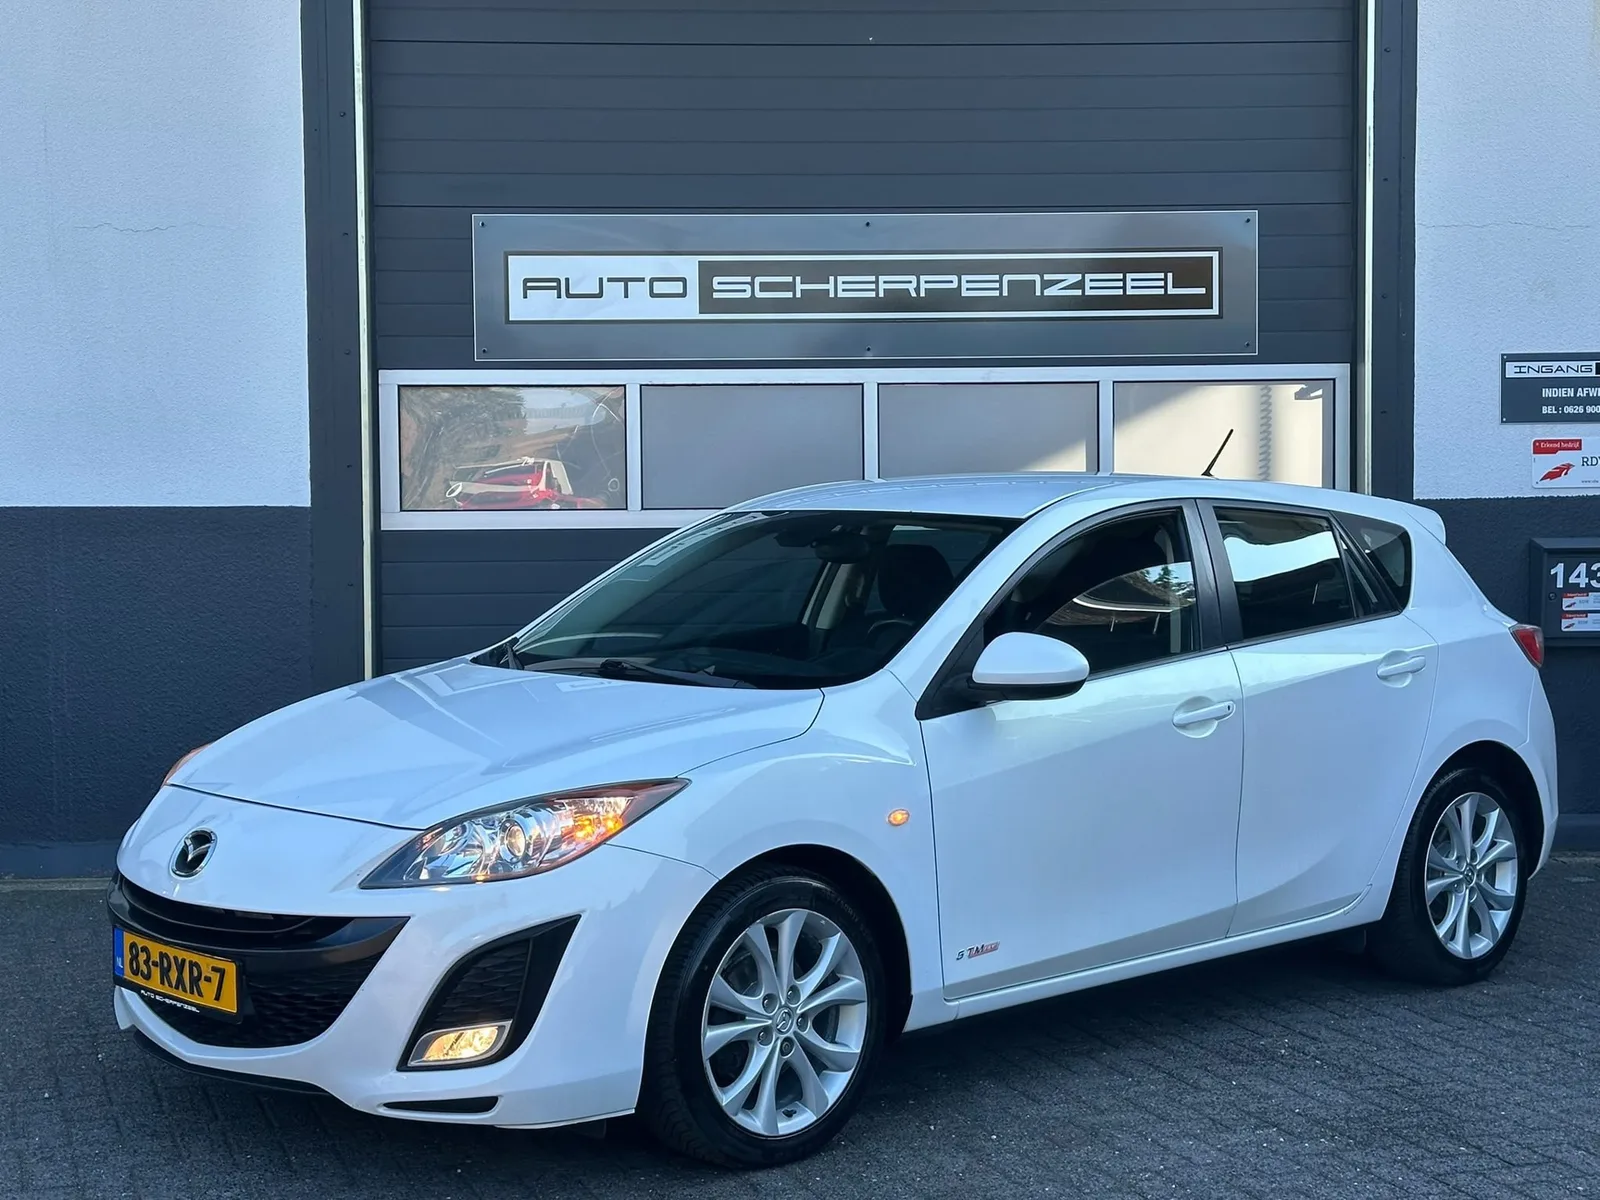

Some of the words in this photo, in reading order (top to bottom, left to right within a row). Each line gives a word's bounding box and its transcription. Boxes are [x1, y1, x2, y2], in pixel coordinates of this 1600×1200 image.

[522, 276, 688, 299] AUTO
[711, 272, 1206, 299] SCHERPENZEEL
[1513, 364, 1593, 374] INGANG
[1542, 387, 1574, 397] INDIEN
[1542, 405, 1557, 414] BEL
[1581, 456, 1600, 467] RD
[128, 941, 226, 1002] 83-RXR-7
